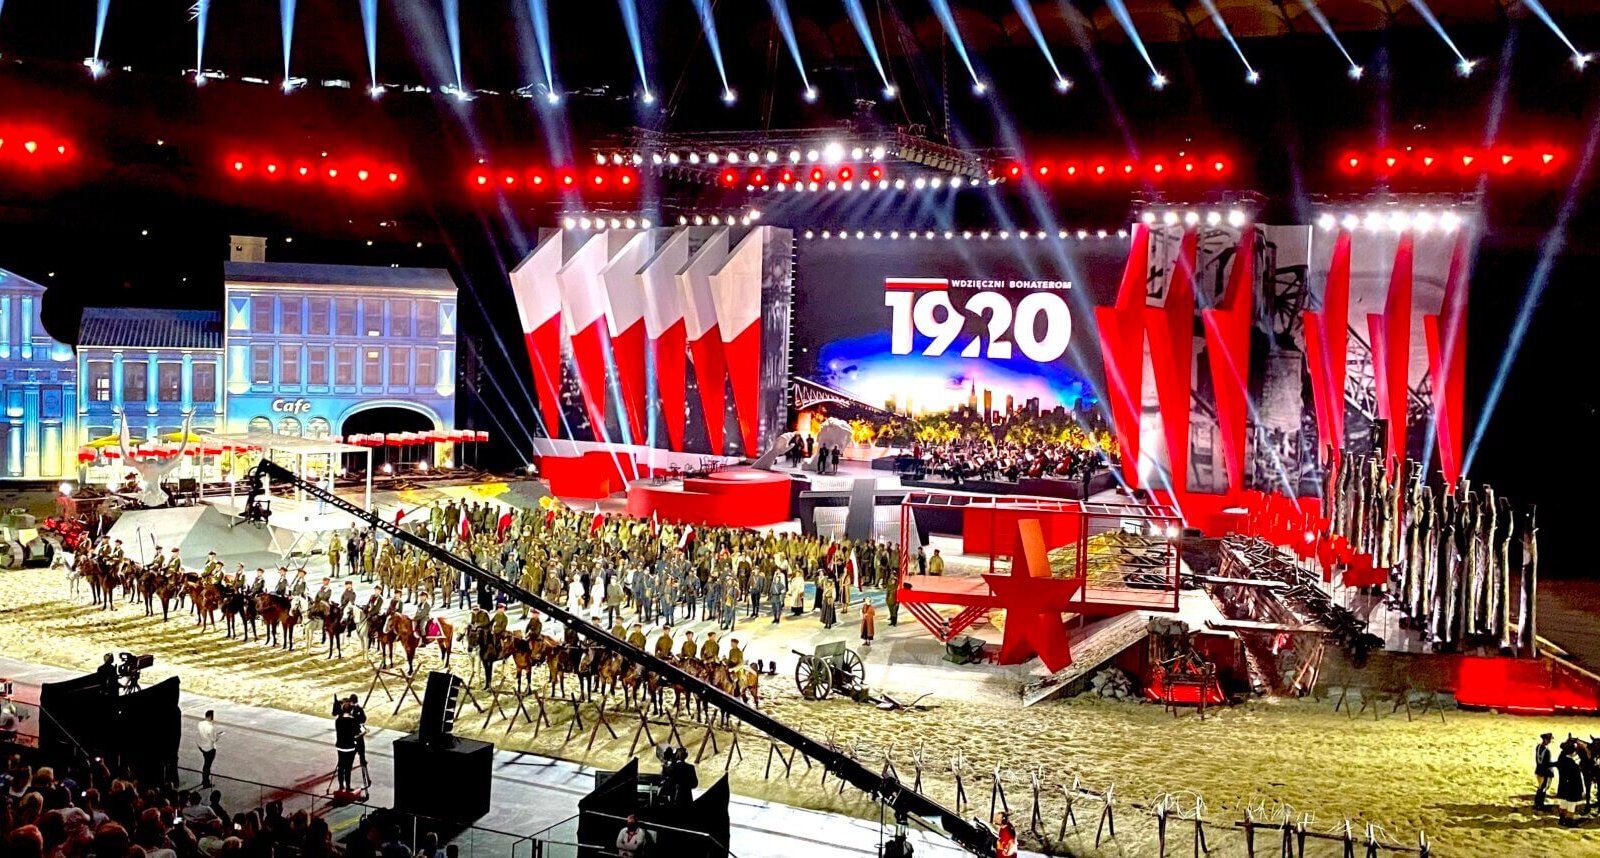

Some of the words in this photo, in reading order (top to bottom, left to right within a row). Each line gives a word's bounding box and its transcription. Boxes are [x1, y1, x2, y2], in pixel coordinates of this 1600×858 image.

[951, 280, 1005, 290] WDZIĘCZNI
[1009, 280, 1072, 289] BOHATEROM
[885, 290, 1072, 362] 1920
[272, 399, 311, 414] Cafe
